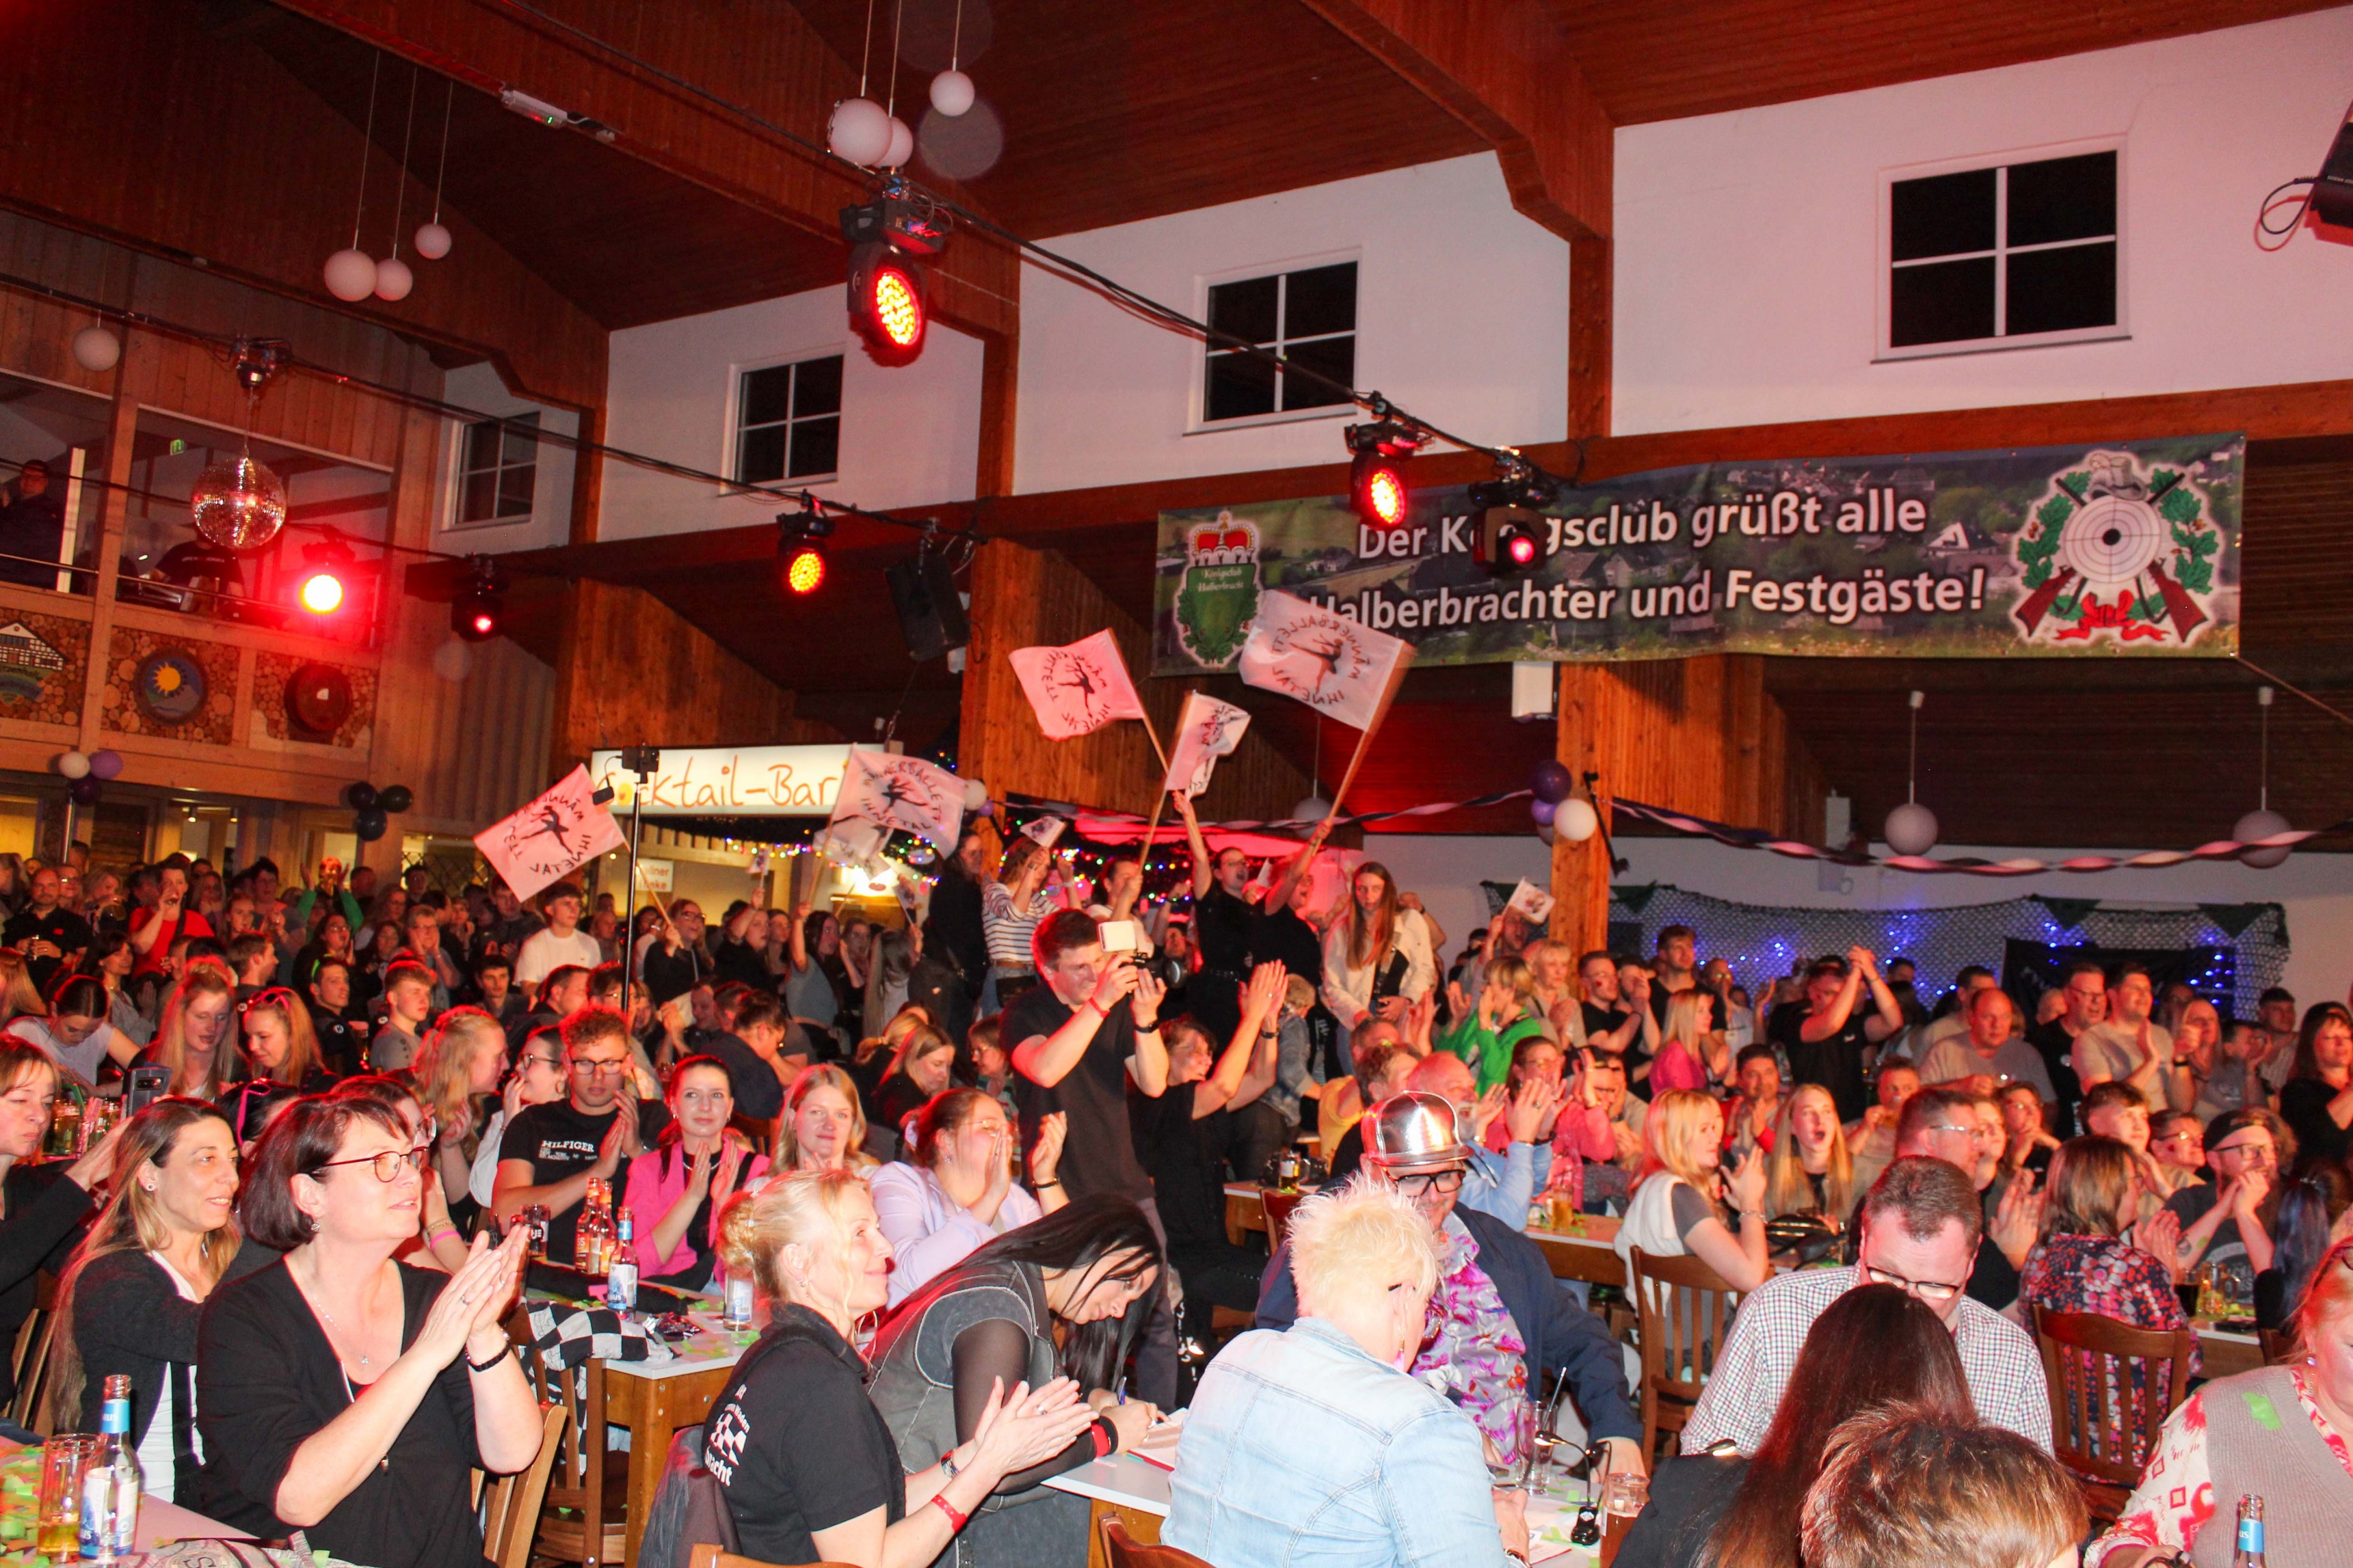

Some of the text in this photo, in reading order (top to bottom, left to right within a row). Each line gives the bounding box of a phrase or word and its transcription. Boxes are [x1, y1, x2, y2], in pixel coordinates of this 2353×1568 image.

[1359, 487, 1926, 559] Der Kgsclub grüßt alle
[1630, 570, 1711, 620] und
[1726, 567, 1986, 625] Festgäste!
[542, 1140, 595, 1153] HILFIGER
